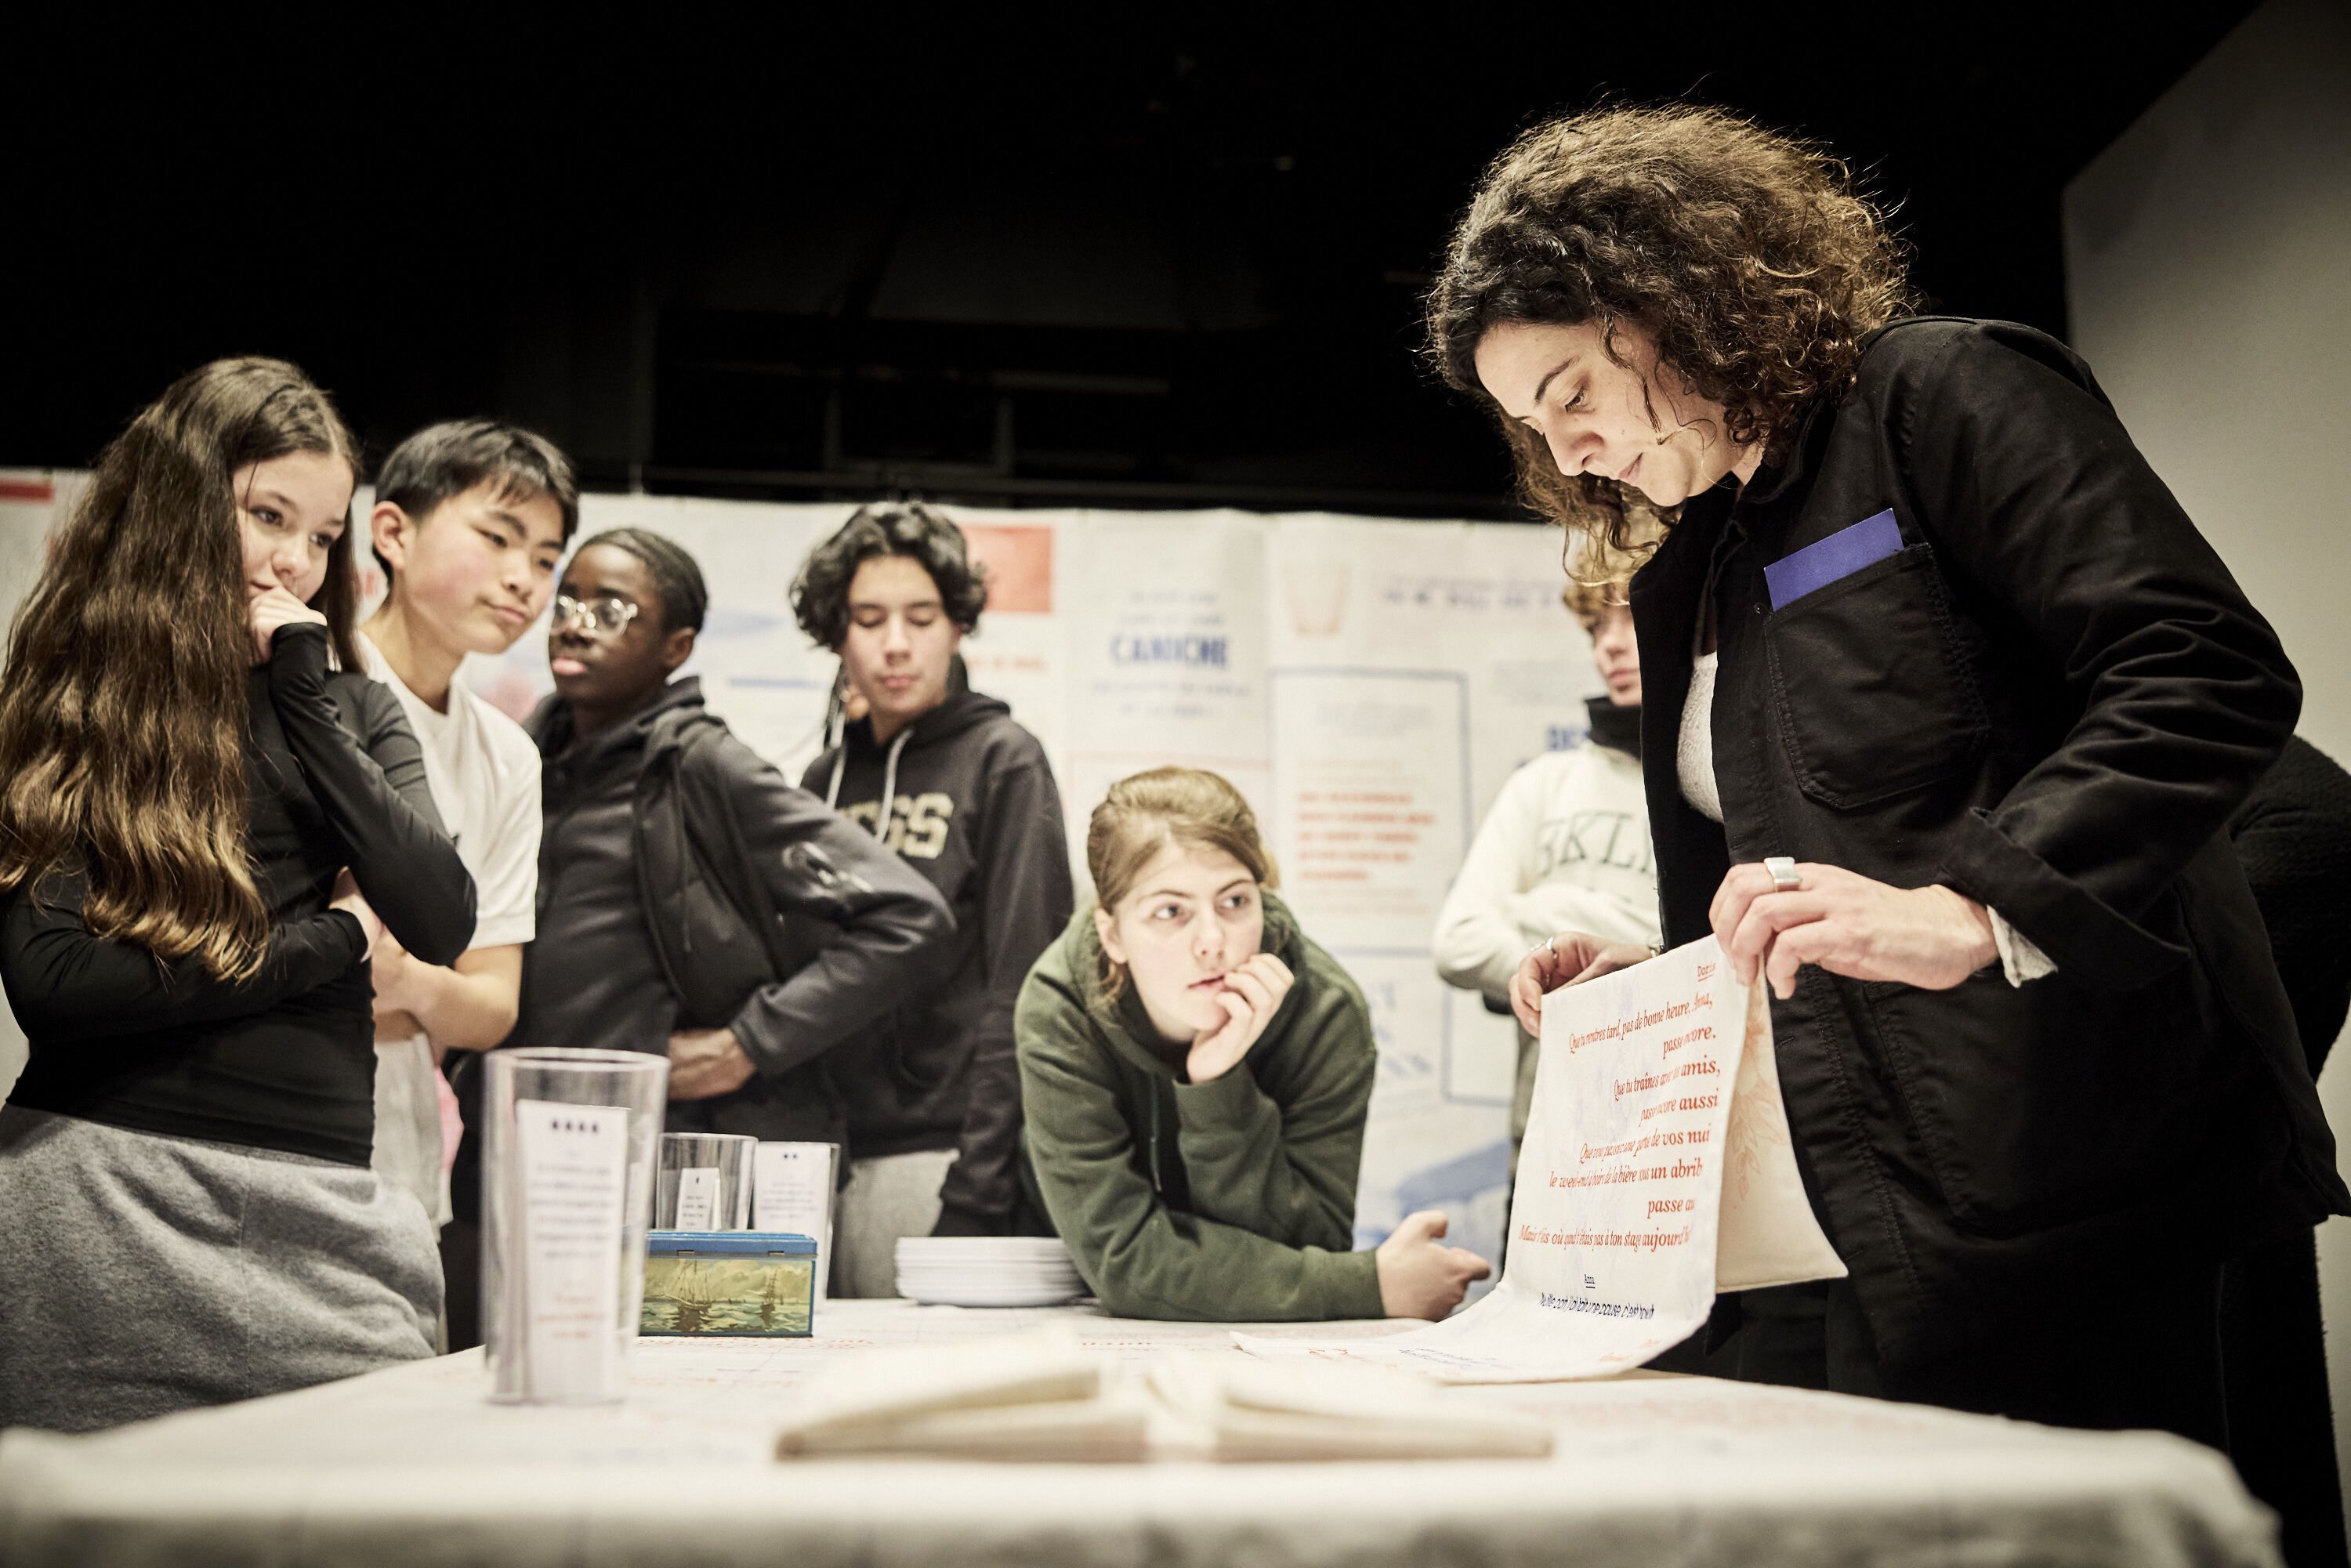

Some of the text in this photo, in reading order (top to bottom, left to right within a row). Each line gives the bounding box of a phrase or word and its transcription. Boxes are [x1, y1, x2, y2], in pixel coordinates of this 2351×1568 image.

[1621, 1019, 1633, 1041] pas
[1634, 1012, 1643, 1030] de
[1643, 1010, 1664, 1027] bonne
[1614, 1079, 1625, 1102] Que
[1626, 1078, 1633, 1094] tu
[1634, 1072, 1660, 1092] traînes
[1681, 1054, 1720, 1077] amis,
[1679, 1088, 1719, 1110] aussi
[1580, 1143, 1592, 1164] Que
[1650, 1128, 1660, 1146] de
[1663, 1131, 1683, 1146] vos
[1549, 1171, 1558, 1187] le
[1617, 1165, 1637, 1183] bière
[1650, 1166, 1667, 1179] un
[1647, 1199, 1682, 1219] passe
[1552, 1228, 1563, 1244] où
[1610, 1229, 1623, 1247] ton
[1625, 1230, 1642, 1252] stage
